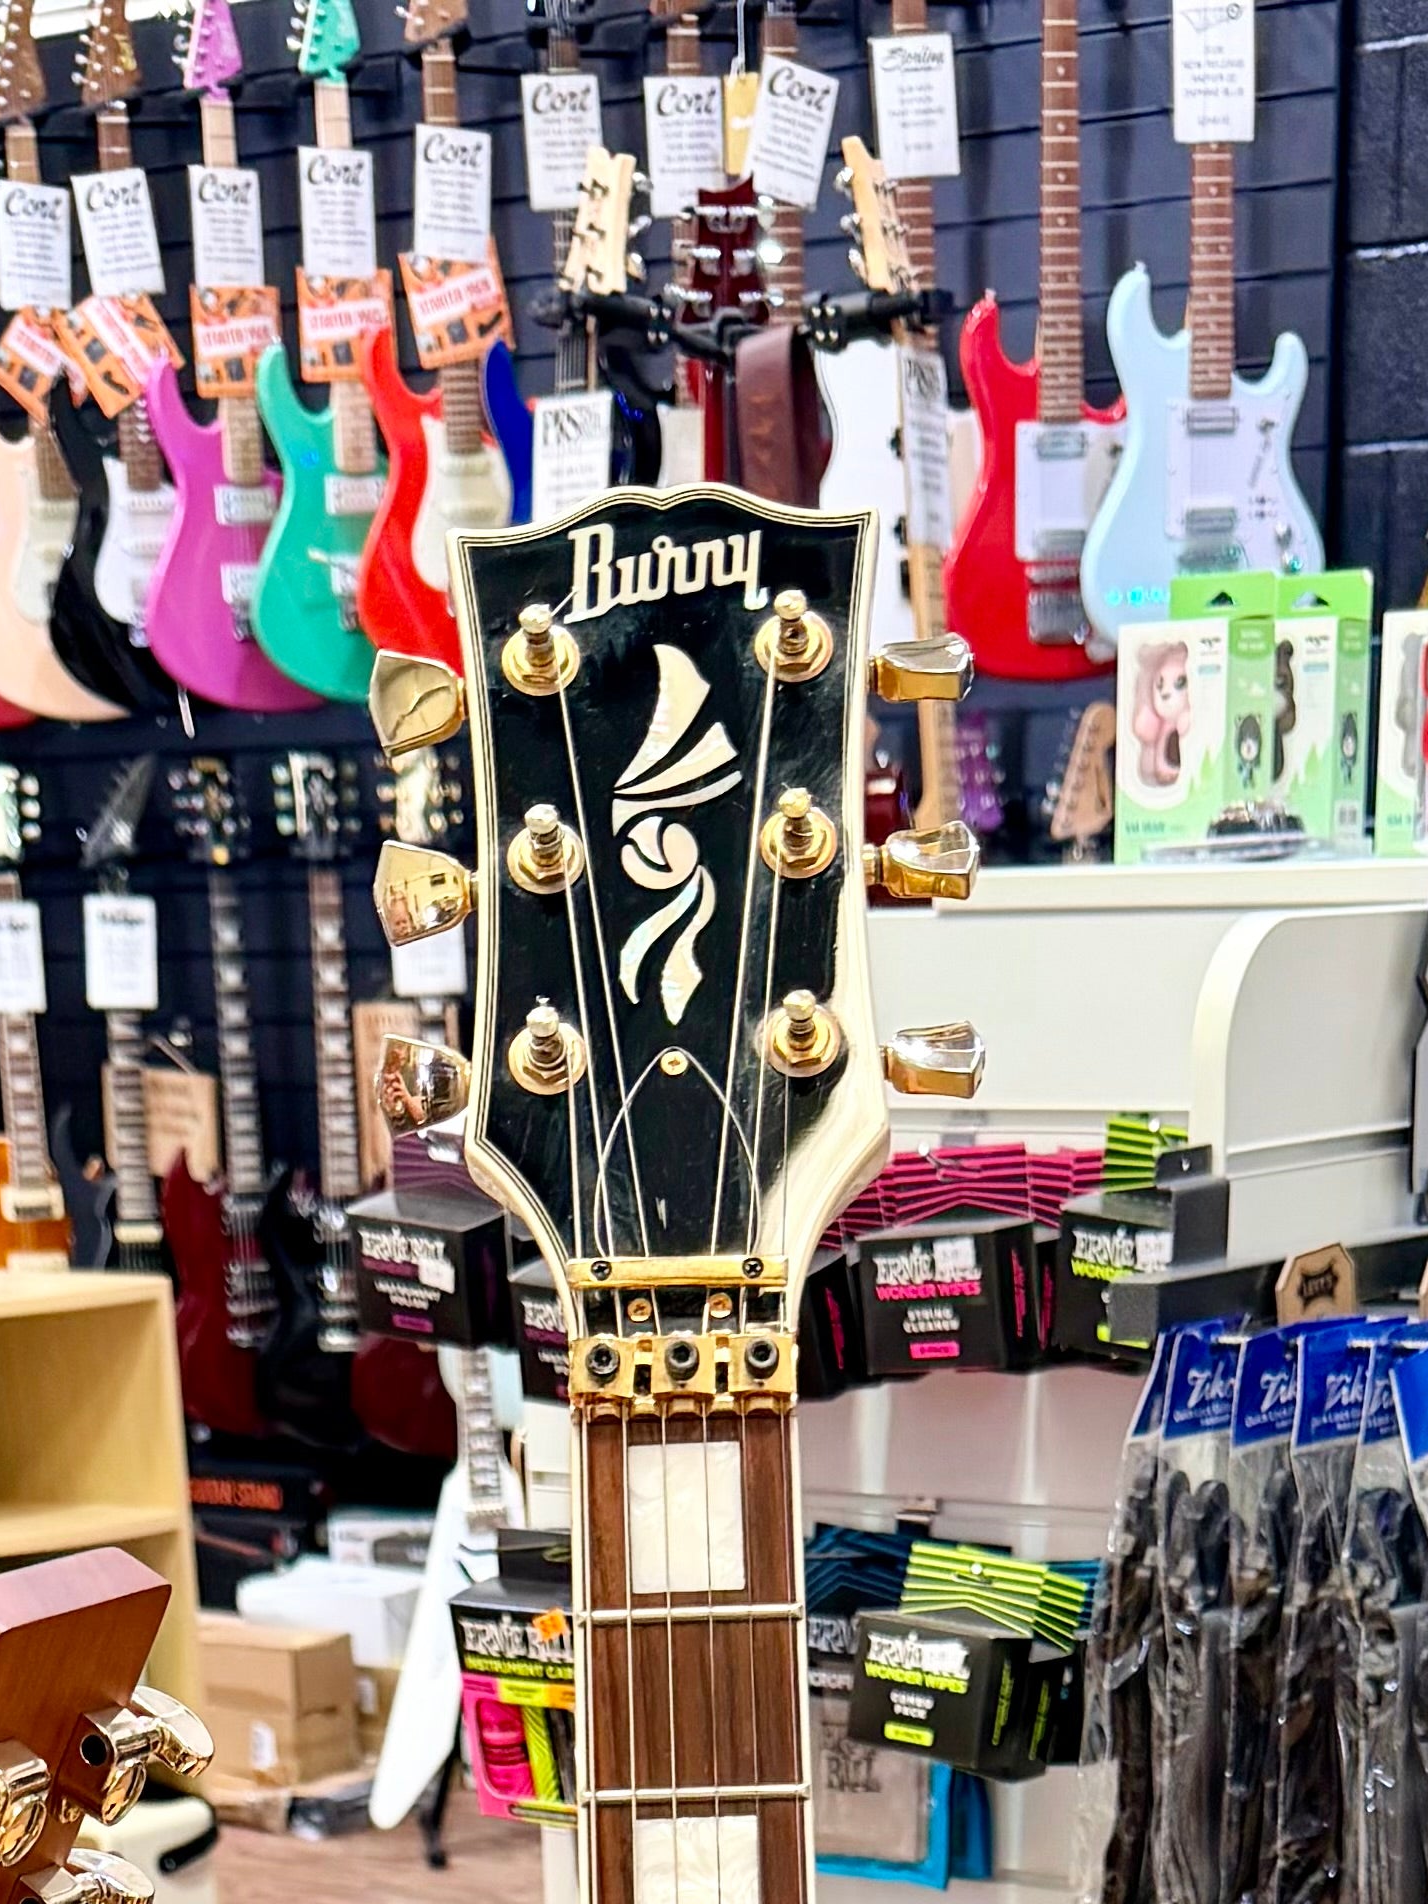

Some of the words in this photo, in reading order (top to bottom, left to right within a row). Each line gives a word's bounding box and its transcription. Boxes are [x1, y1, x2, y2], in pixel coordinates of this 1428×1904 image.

[531, 82, 592, 115] Cort
[656, 85, 717, 117] Cort
[768, 66, 831, 112] Cort
[423, 133, 483, 168] Cort
[307, 155, 365, 187] Cort
[5, 188, 62, 221] Cort
[87, 180, 142, 213] Cort
[198, 173, 252, 206] Cort
[563, 523, 769, 624] Burny
[872, 1244, 933, 1284] ERNIE
[1072, 1227, 1136, 1270] ERNIE
[875, 1283, 938, 1303] WONDER
[937, 1281, 982, 1298] WIPES
[460, 1613, 524, 1656] ERNIE
[867, 1632, 924, 1669] ERNIE
[864, 1661, 923, 1686] WONDER
